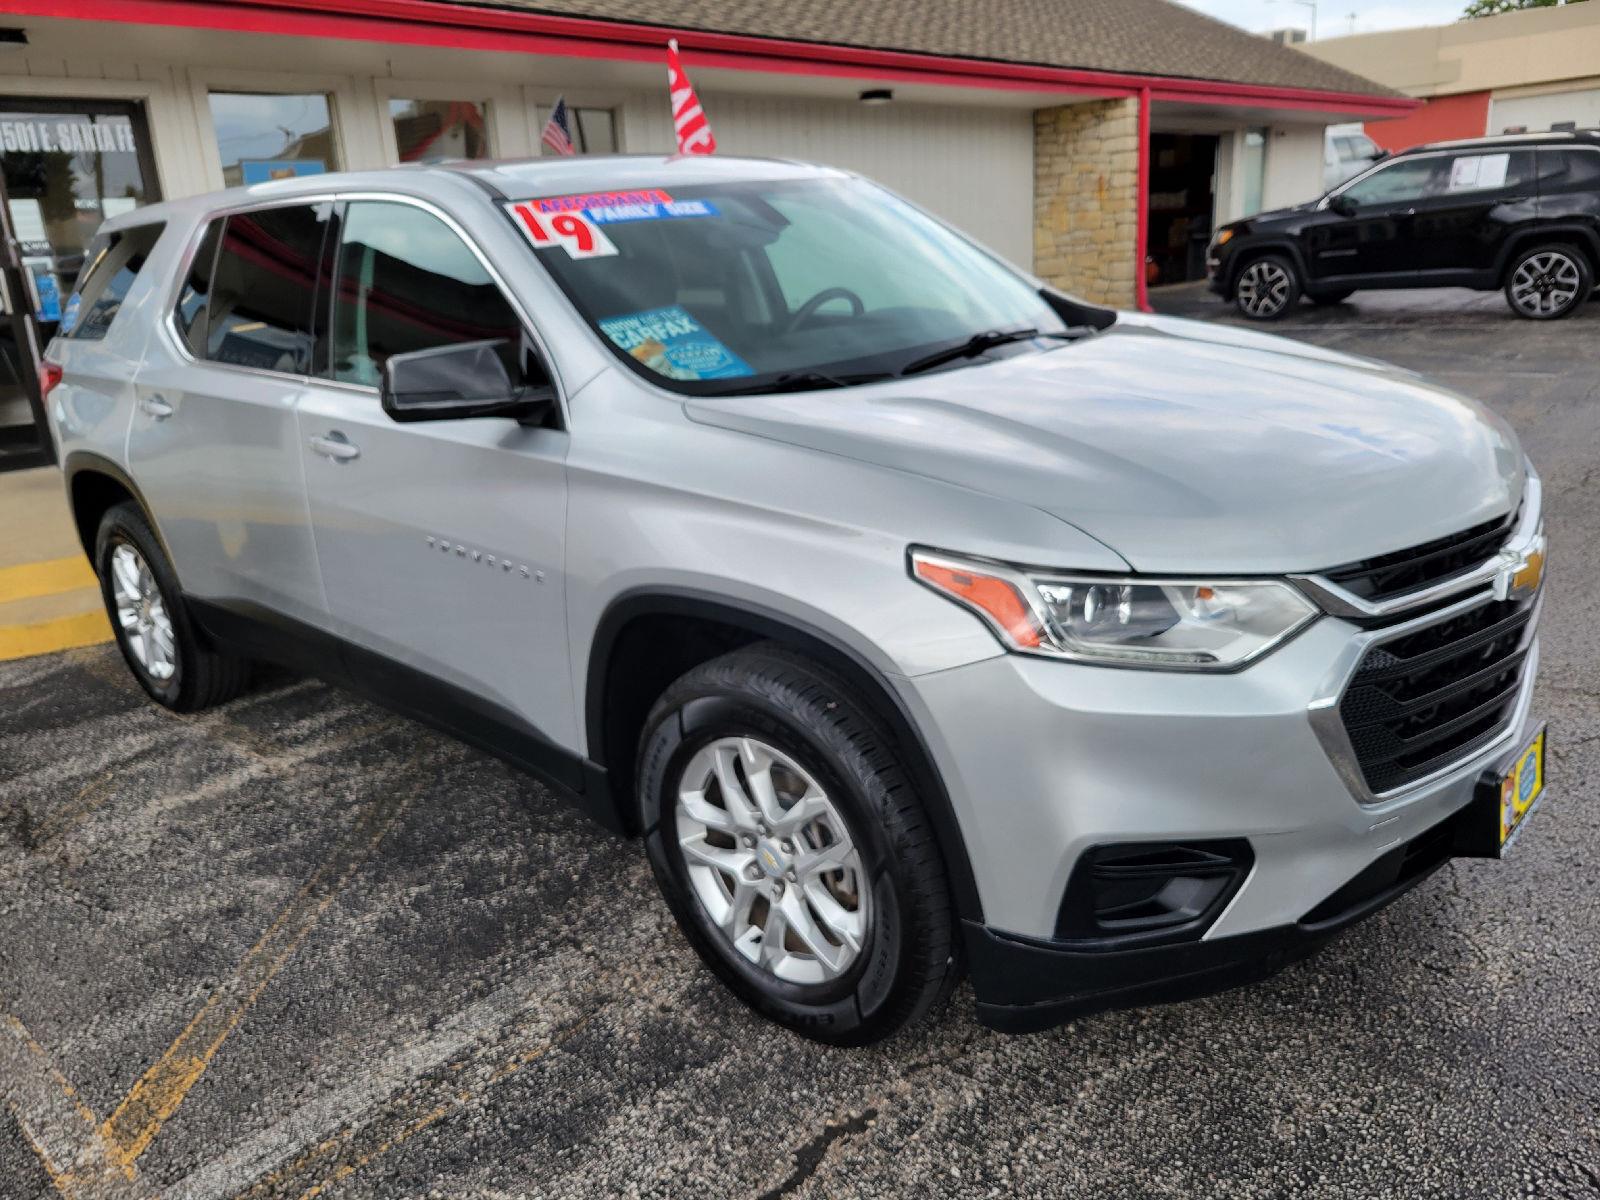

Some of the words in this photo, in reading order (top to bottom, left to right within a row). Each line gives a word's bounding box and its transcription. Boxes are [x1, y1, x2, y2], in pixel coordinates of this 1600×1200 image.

[57, 123, 119, 153] SANTA
[587, 201, 658, 223] FAMILY
[609, 317, 700, 349] CARFAX
